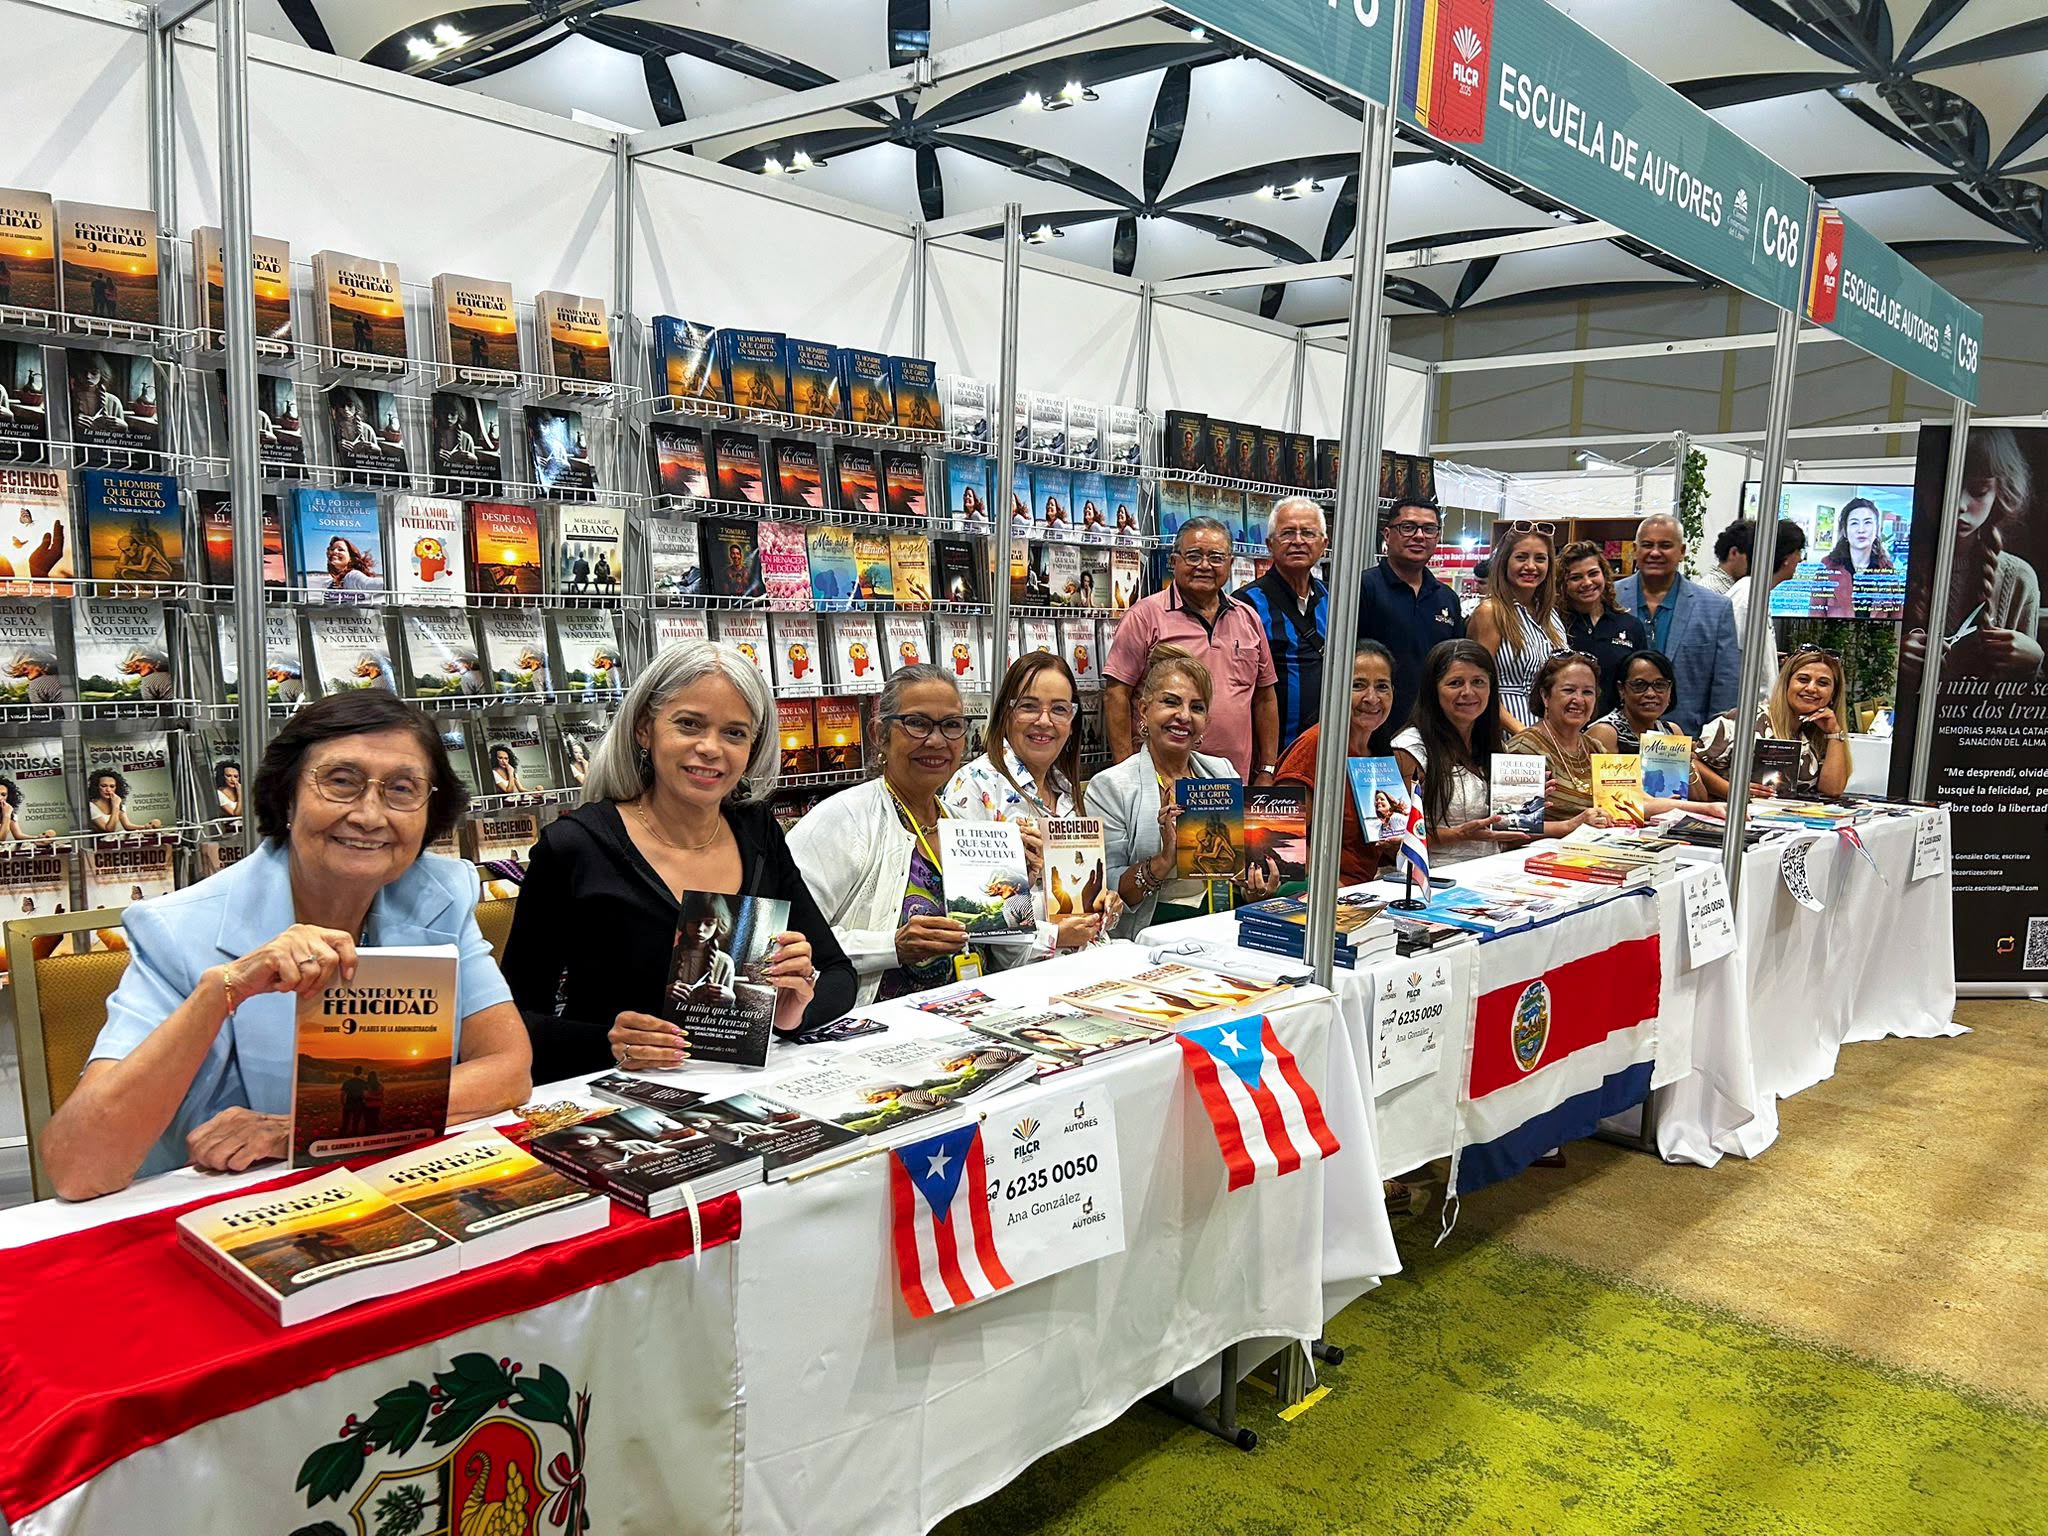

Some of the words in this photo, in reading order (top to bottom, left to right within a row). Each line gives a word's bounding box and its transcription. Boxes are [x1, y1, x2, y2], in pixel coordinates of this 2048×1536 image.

[1452, 61, 1480, 88] FILCR
[1498, 62, 1605, 165] ESCUELA
[1609, 129, 1639, 181] DE
[1639, 150, 1723, 228] AUTORES
[1762, 206, 1800, 268] C68
[74, 221, 130, 236] CONSTRUYE
[133, 228, 146, 237] TU
[74, 229, 147, 247] FELICIDAD
[338, 276, 393, 294] FELICIDAD
[456, 296, 507, 312] FELICIDAD
[556, 311, 601, 326] FELICIDAD
[1841, 268, 1887, 322] ESCUELA
[1888, 299, 1902, 330] DE
[1900, 308, 1939, 353] AUTORES
[1958, 332, 1979, 374] C58
[103, 478, 115, 487] EL
[118, 479, 163, 490] HOMBRE
[106, 487, 129, 497] QUE
[131, 488, 161, 499] GRITA
[103, 496, 118, 505] EN
[119, 497, 166, 508] SILENCIO
[328, 499, 361, 508] PODER
[411, 505, 421, 516] EL
[424, 506, 448, 519] AMOR
[481, 512, 510, 523] DESDE
[513, 514, 532, 525] UNA
[318, 518, 361, 528] SONRISA
[401, 517, 457, 532] INTELIGENTE
[492, 524, 523, 535] BANCA
[564, 523, 577, 533] LA
[581, 524, 620, 536] BANCA
[90, 605, 104, 615] EL
[107, 605, 149, 615] TIEMPO
[91, 615, 113, 626] QUE
[114, 615, 128, 625] SE
[130, 615, 149, 625] VA
[83, 626, 91, 635] Y
[94, 626, 113, 636] NO
[116, 626, 158, 636] VUELVE
[1946, 675, 1990, 696] niña
[1994, 682, 2028, 700] que
[1938, 703, 1968, 720] sus
[1972, 700, 2004, 719] dos
[1938, 726, 1983, 736] MEMORIAS
[1985, 727, 2007, 736] PARA
[2009, 727, 2020, 736] LA
[1958, 736, 2002, 746] SANACIÓN
[2004, 738, 2020, 746] DEL
[2022, 738, 2047, 747] ALMA
[90, 749, 165, 765] SONRISAS
[130, 761, 158, 770] FALSAS
[23, 769, 54, 778] FALSAS
[1966, 768, 2017, 779] desprendí,
[1187, 784, 1197, 792] EL
[1198, 783, 1232, 791] HOMBRE
[1937, 785, 1975, 797] busqué
[1977, 785, 1986, 794] la
[1988, 785, 2031, 796] felicidad,
[1189, 790, 1206, 799] QUE
[1207, 790, 1231, 798] GRITA
[1186, 798, 1197, 806] EN
[1198, 797, 1234, 805] SILENCIO
[1971, 803, 1994, 813] todo
[1998, 803, 2006, 813] la
[27, 806, 66, 814] VIOLENCIA
[1250, 805, 1263, 814] EL
[1265, 805, 1300, 814] LÍMITE
[483, 819, 533, 835] CRECIENDO
[955, 828, 967, 837] EL
[968, 829, 1008, 839] TIEMPO
[1048, 820, 1099, 834] CRECIENDO
[956, 839, 980, 849] QUE
[980, 839, 993, 848] SE
[994, 840, 1009, 849] VA
[94, 849, 167, 868] CRECIENDO
[950, 848, 959, 857] Y
[959, 849, 977, 858] NO
[978, 850, 1017, 859] VUELVE
[323, 987, 414, 999] CONSTRUYE
[419, 987, 438, 999] TU
[323, 999, 439, 1016] FELICIDAD
[675, 1001, 689, 1011] La
[689, 1002, 711, 1013] niña
[711, 1006, 729, 1016] que
[729, 1008, 740, 1017] se
[740, 1009, 765, 1019] cortó
[1397, 1009, 1420, 1026] 6235
[1421, 1003, 1443, 1020] 0050
[342, 1018, 357, 1035] 9
[358, 1025, 380, 1033] PILARES
[394, 1024, 438, 1033] ADMINISTRACIÓN
[684, 1015, 700, 1023] sus
[700, 1014, 716, 1024] dos
[717, 1017, 752, 1029] trenzas
[1013, 1139, 1041, 1160] FILCR
[1063, 1117, 1099, 1135] AUTORES
[1005, 1168, 1049, 1201] 6235
[1051, 1153, 1098, 1184] 0050
[1006, 1209, 1029, 1227] Ana
[1030, 1191, 1081, 1217] González
[1072, 1211, 1106, 1231] AUTORES
